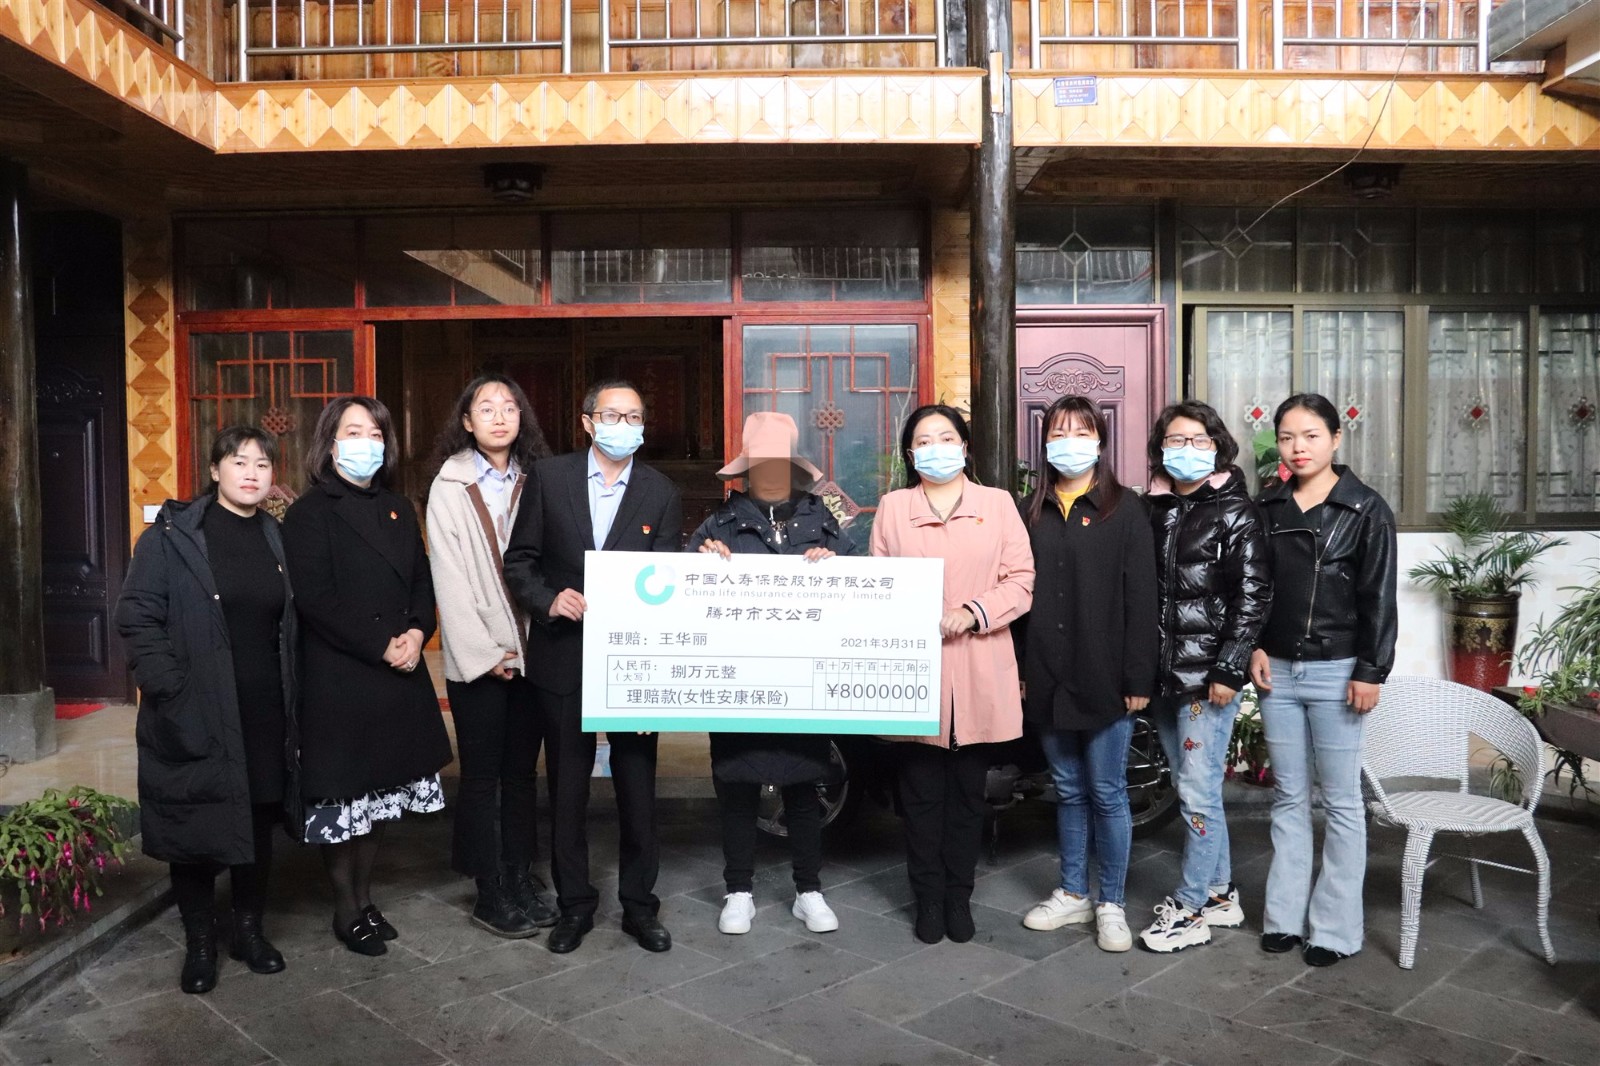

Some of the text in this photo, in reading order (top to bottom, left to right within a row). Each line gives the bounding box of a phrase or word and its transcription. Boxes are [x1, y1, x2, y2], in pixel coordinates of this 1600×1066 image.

[684, 573, 894, 589] 中国人寿保险股份有限公司
[684, 588, 892, 601] China life insurance company limited
[705, 606, 822, 621] 腾冲市支公司
[840, 637, 926, 649] 2021年3月31日
[671, 664, 736, 679] 捌万元整
